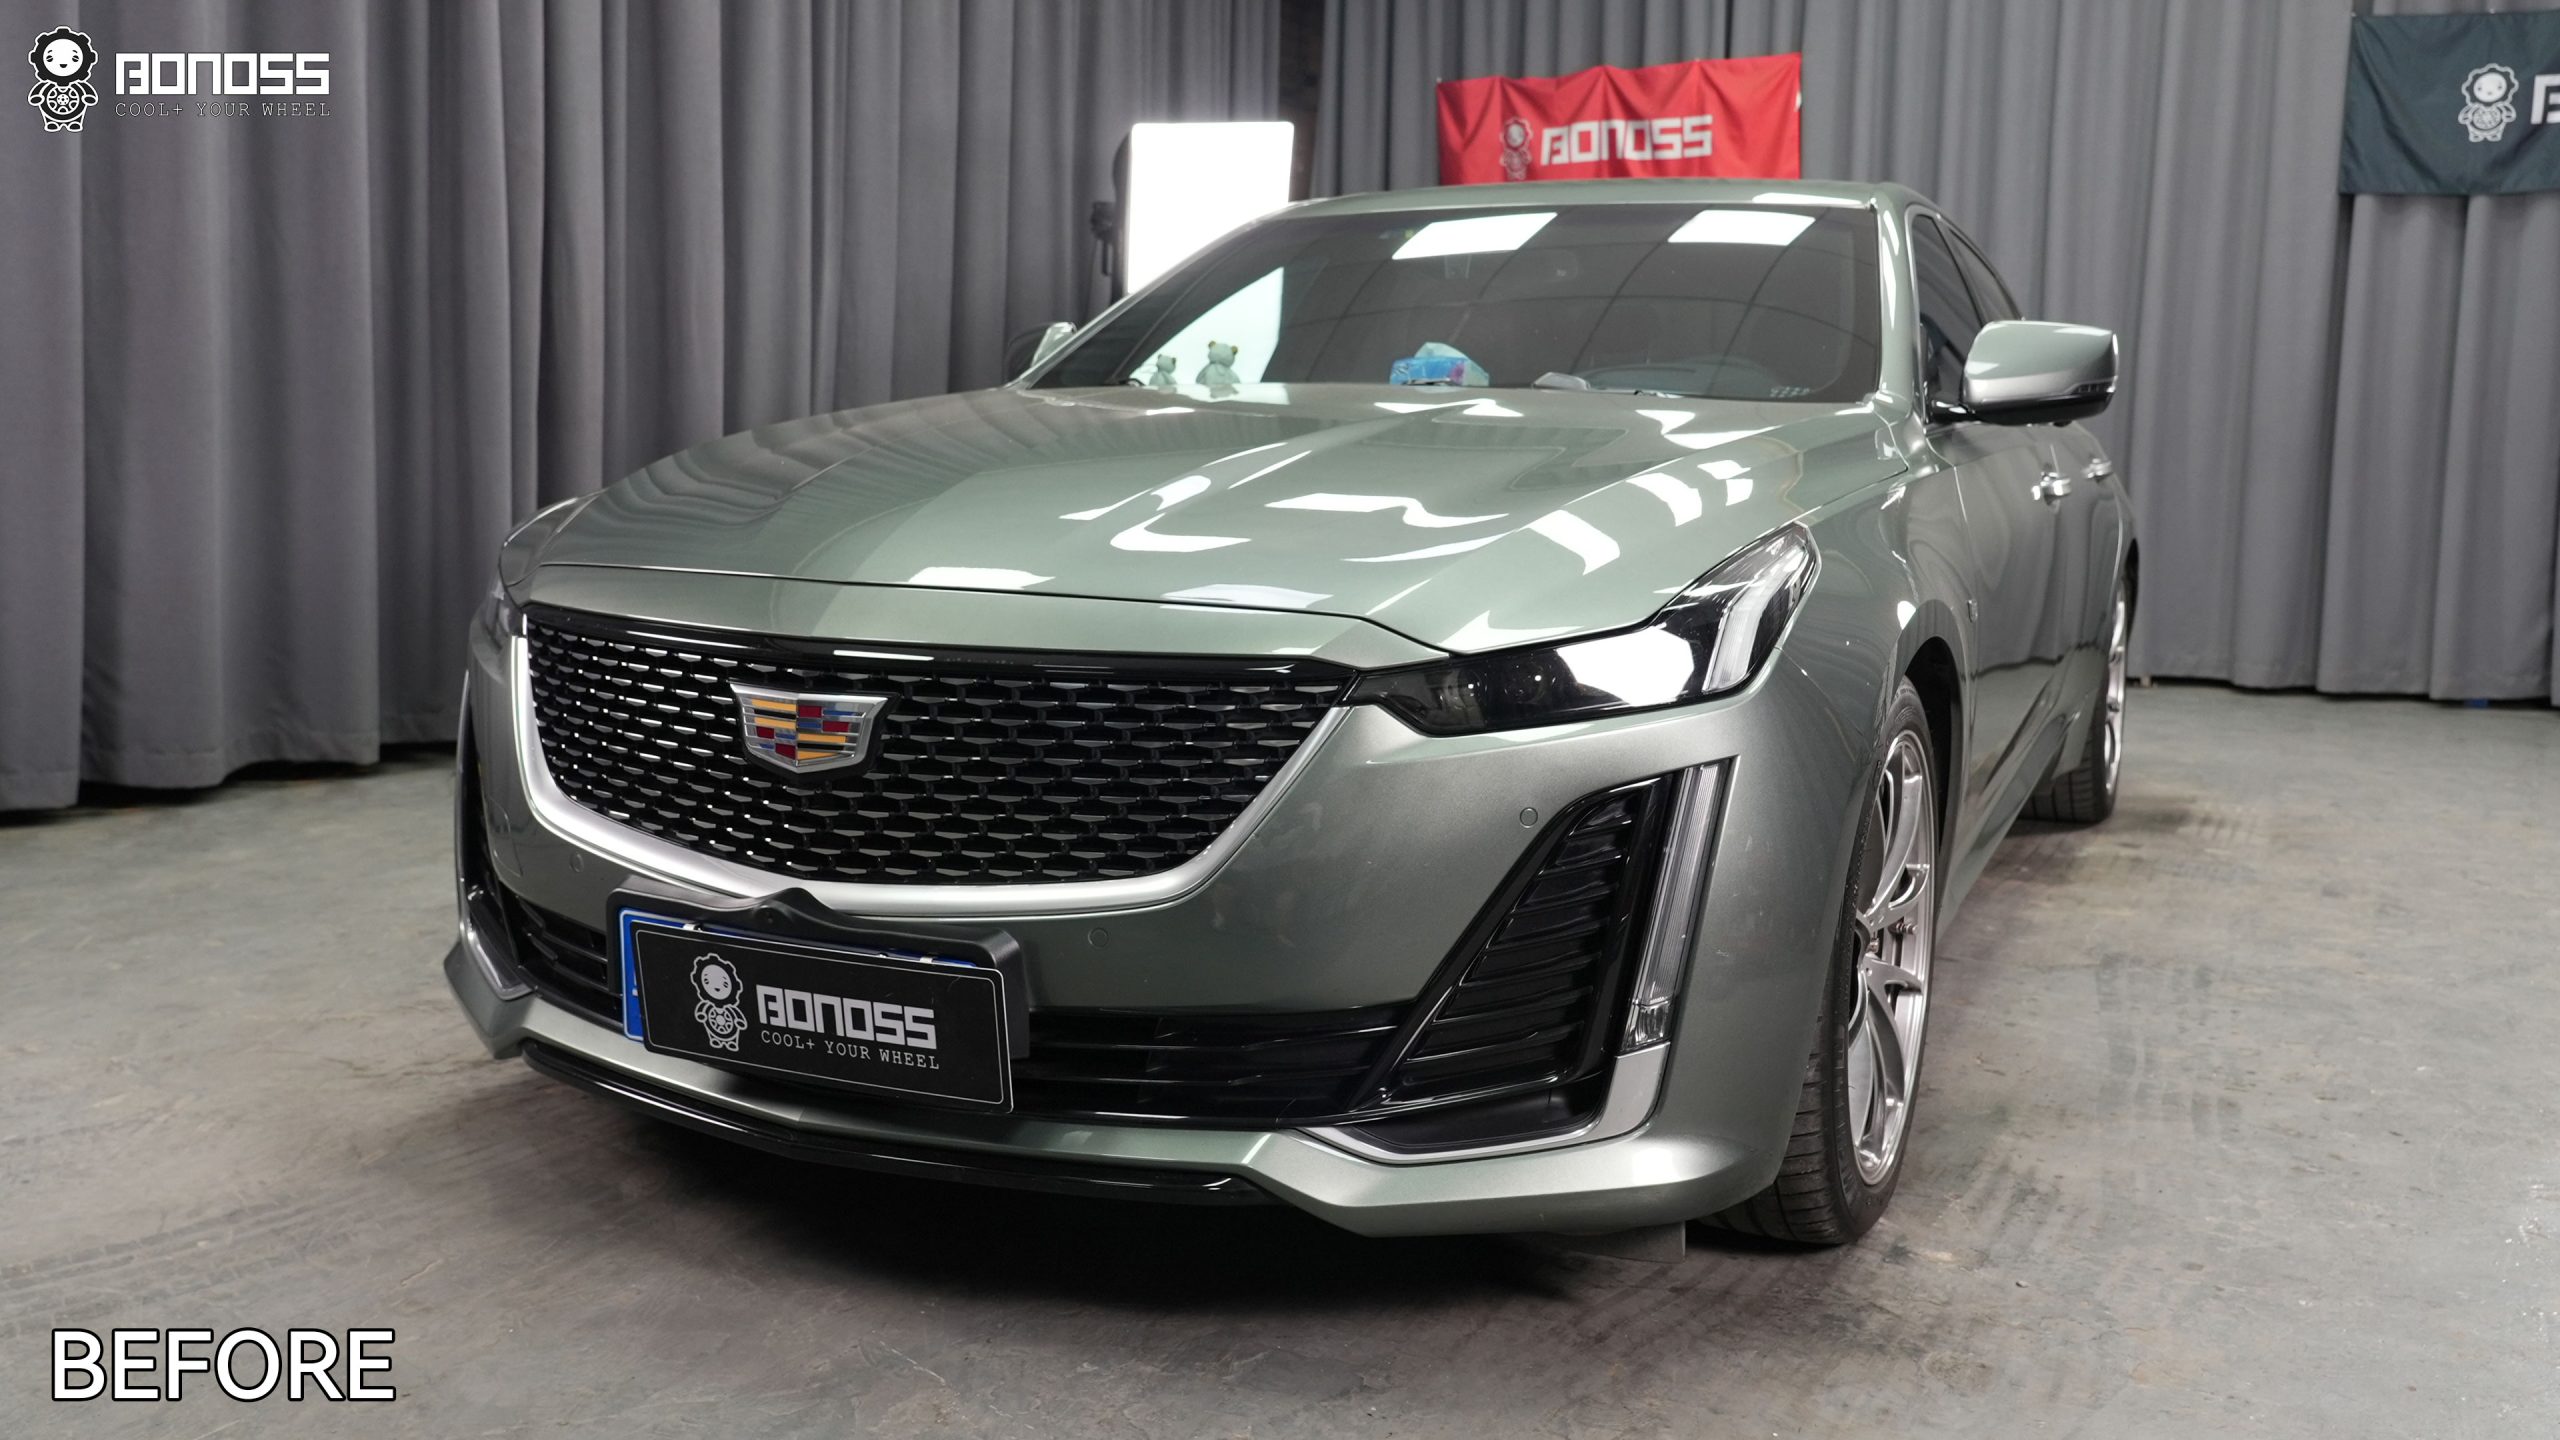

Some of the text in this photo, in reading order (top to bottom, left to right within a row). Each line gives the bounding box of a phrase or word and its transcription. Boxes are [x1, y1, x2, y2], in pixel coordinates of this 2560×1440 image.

[1541, 114, 1713, 166] BONOSS
[756, 985, 937, 1049] BONOSS
[760, 1031, 940, 1070] COOL+ YOUR WHEEL
